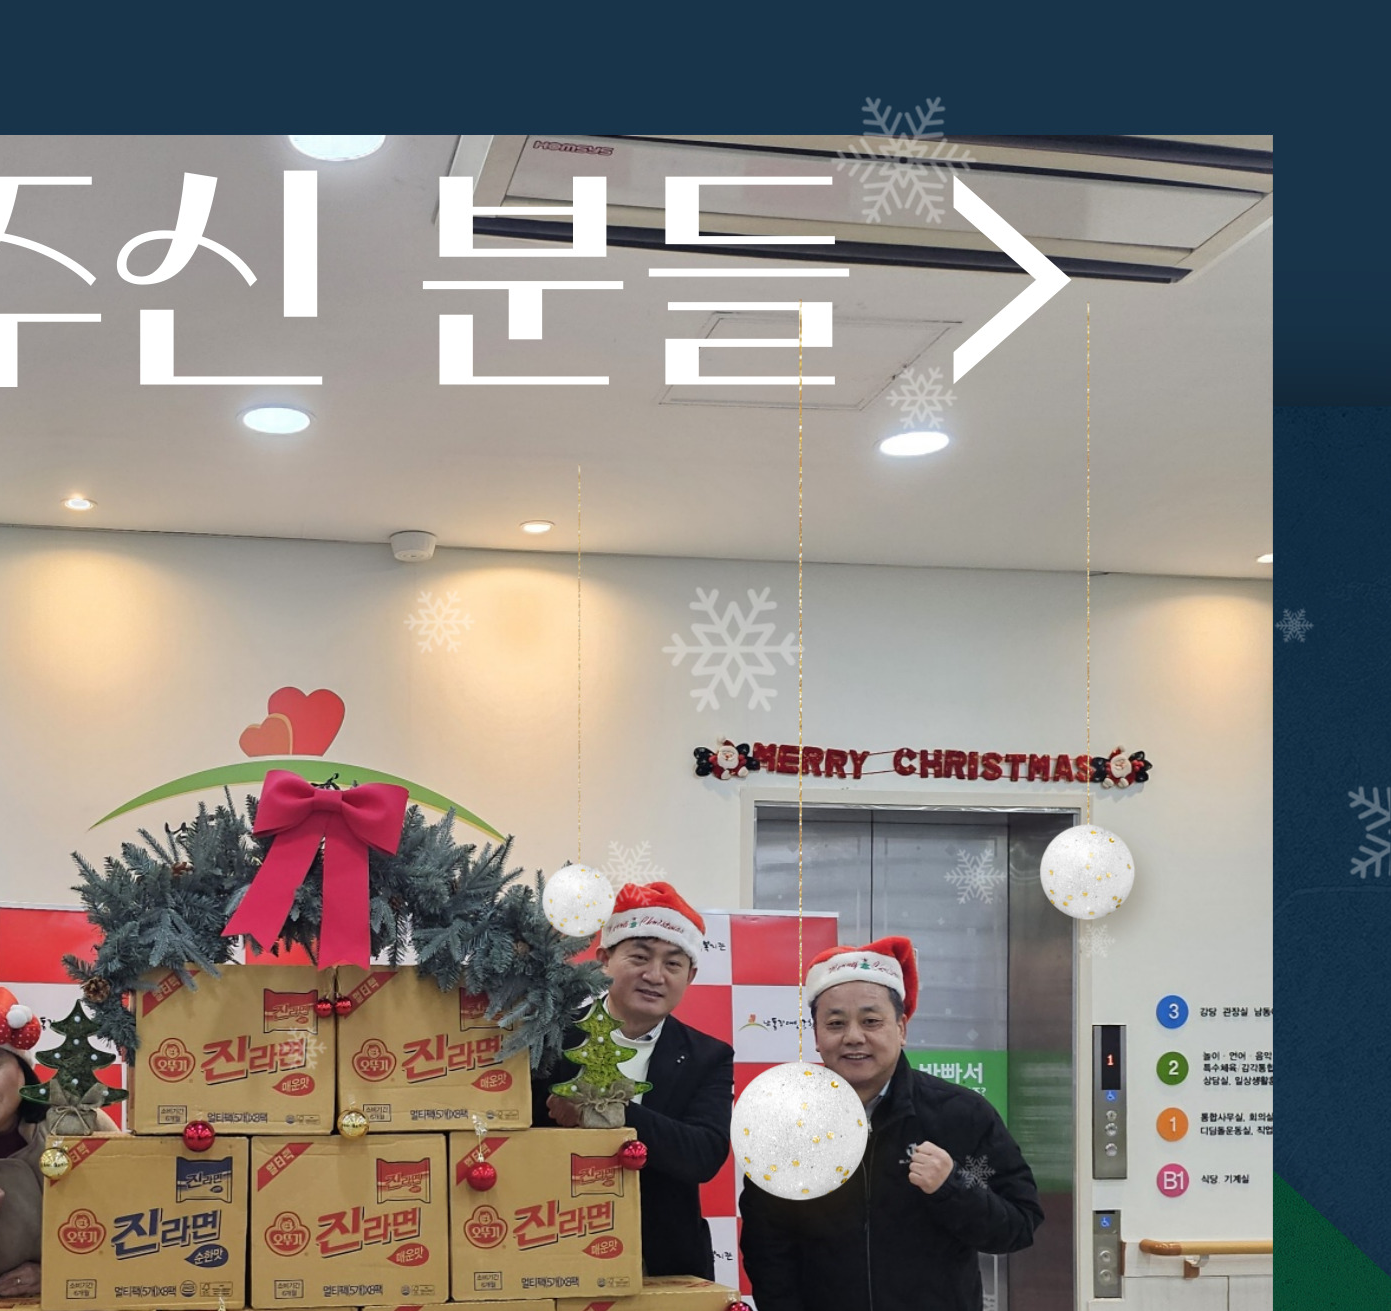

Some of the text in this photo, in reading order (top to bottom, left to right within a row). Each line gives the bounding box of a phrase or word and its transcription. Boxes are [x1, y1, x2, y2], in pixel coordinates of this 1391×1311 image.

[752, 742, 1096, 784] MERRY CHRISTMAS
[1168, 1003, 1180, 1019] 3
[1200, 1007, 1248, 1017] 강당 관장실
[156, 1058, 190, 1076] 오뚜기
[200, 1035, 309, 1084] 진라면
[1168, 1060, 1180, 1076] 2
[1169, 1116, 1177, 1133] 1
[1163, 1171, 1184, 1190] B1
[1224, 1174, 1250, 1184] 기계실
[111, 1208, 221, 1260] 진라면
[316, 1206, 420, 1258] 진라면
[512, 1202, 615, 1250] 진라면
[64, 1230, 101, 1248] 오뚜기
